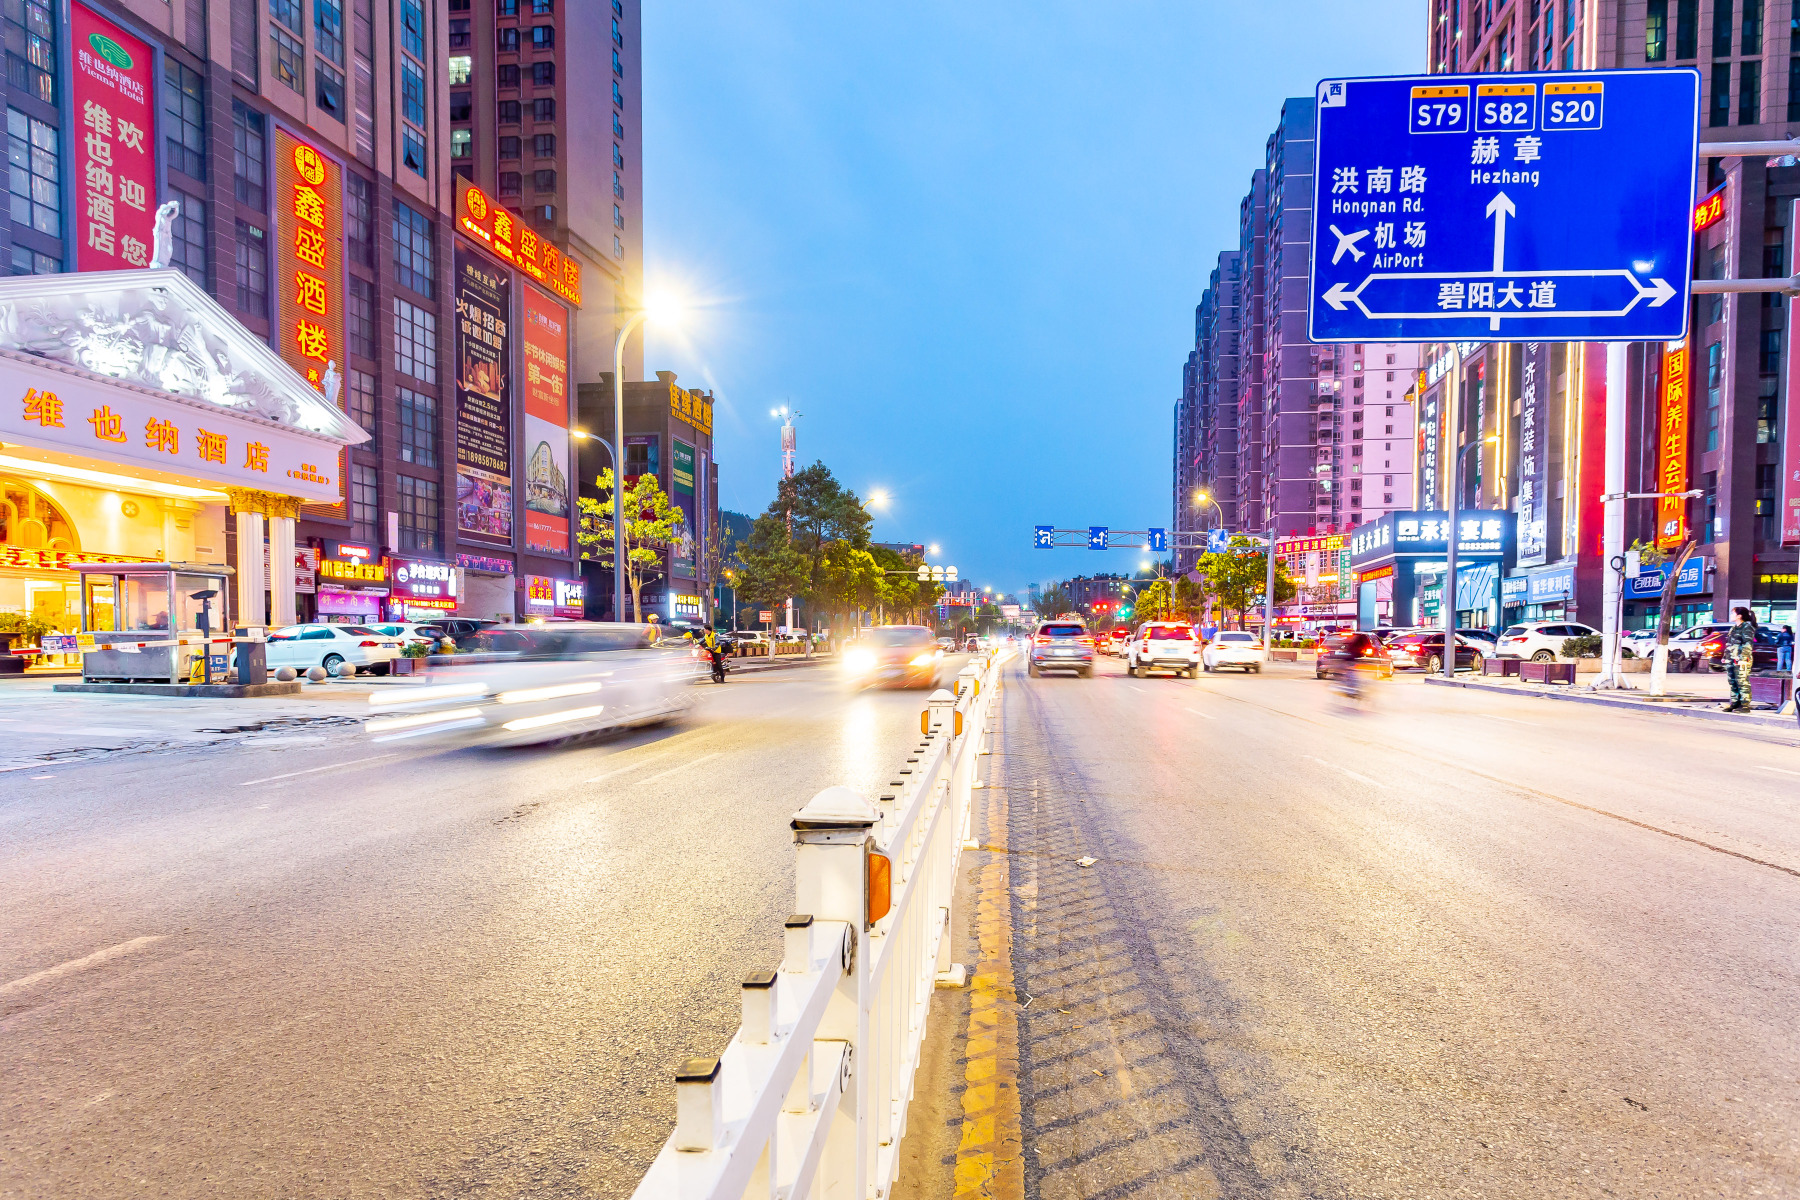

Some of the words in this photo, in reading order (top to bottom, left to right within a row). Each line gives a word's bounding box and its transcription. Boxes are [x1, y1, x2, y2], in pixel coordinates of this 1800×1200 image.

[78, 48, 144, 96] 维也纳酒店
[78, 60, 115, 88] Vienna
[119, 84, 144, 105] Hotel
[1329, 82, 1343, 96] 西
[1417, 103, 1462, 127] S79
[1484, 102, 1528, 125] S82
[1550, 100, 1595, 123] S20
[1471, 135, 1542, 165] 赫章
[83, 99, 115, 257] 维也纳酒店
[117, 117, 148, 268] 欢迎您
[1331, 165, 1427, 194] 洪南路
[1470, 168, 1540, 188] Hezhang
[1332, 198, 1396, 217] Hongnan
[1402, 197, 1425, 213] Rd.
[494, 209, 579, 289] 鑫盛酒楼
[1374, 221, 1427, 249] 机场
[294, 184, 328, 363] 鑫盛酒楼
[1372, 252, 1424, 268] AirPort
[552, 277, 580, 303] 7159666
[1437, 280, 1557, 310] 碧阳大道
[455, 296, 506, 338] 火爆招商
[461, 318, 502, 350] 诚邀加盟
[527, 361, 563, 396] 第一街
[23, 387, 271, 474] 维也纳酒店
[1663, 351, 1684, 511] 国际养生会所
[1664, 520, 1678, 536] 4F
